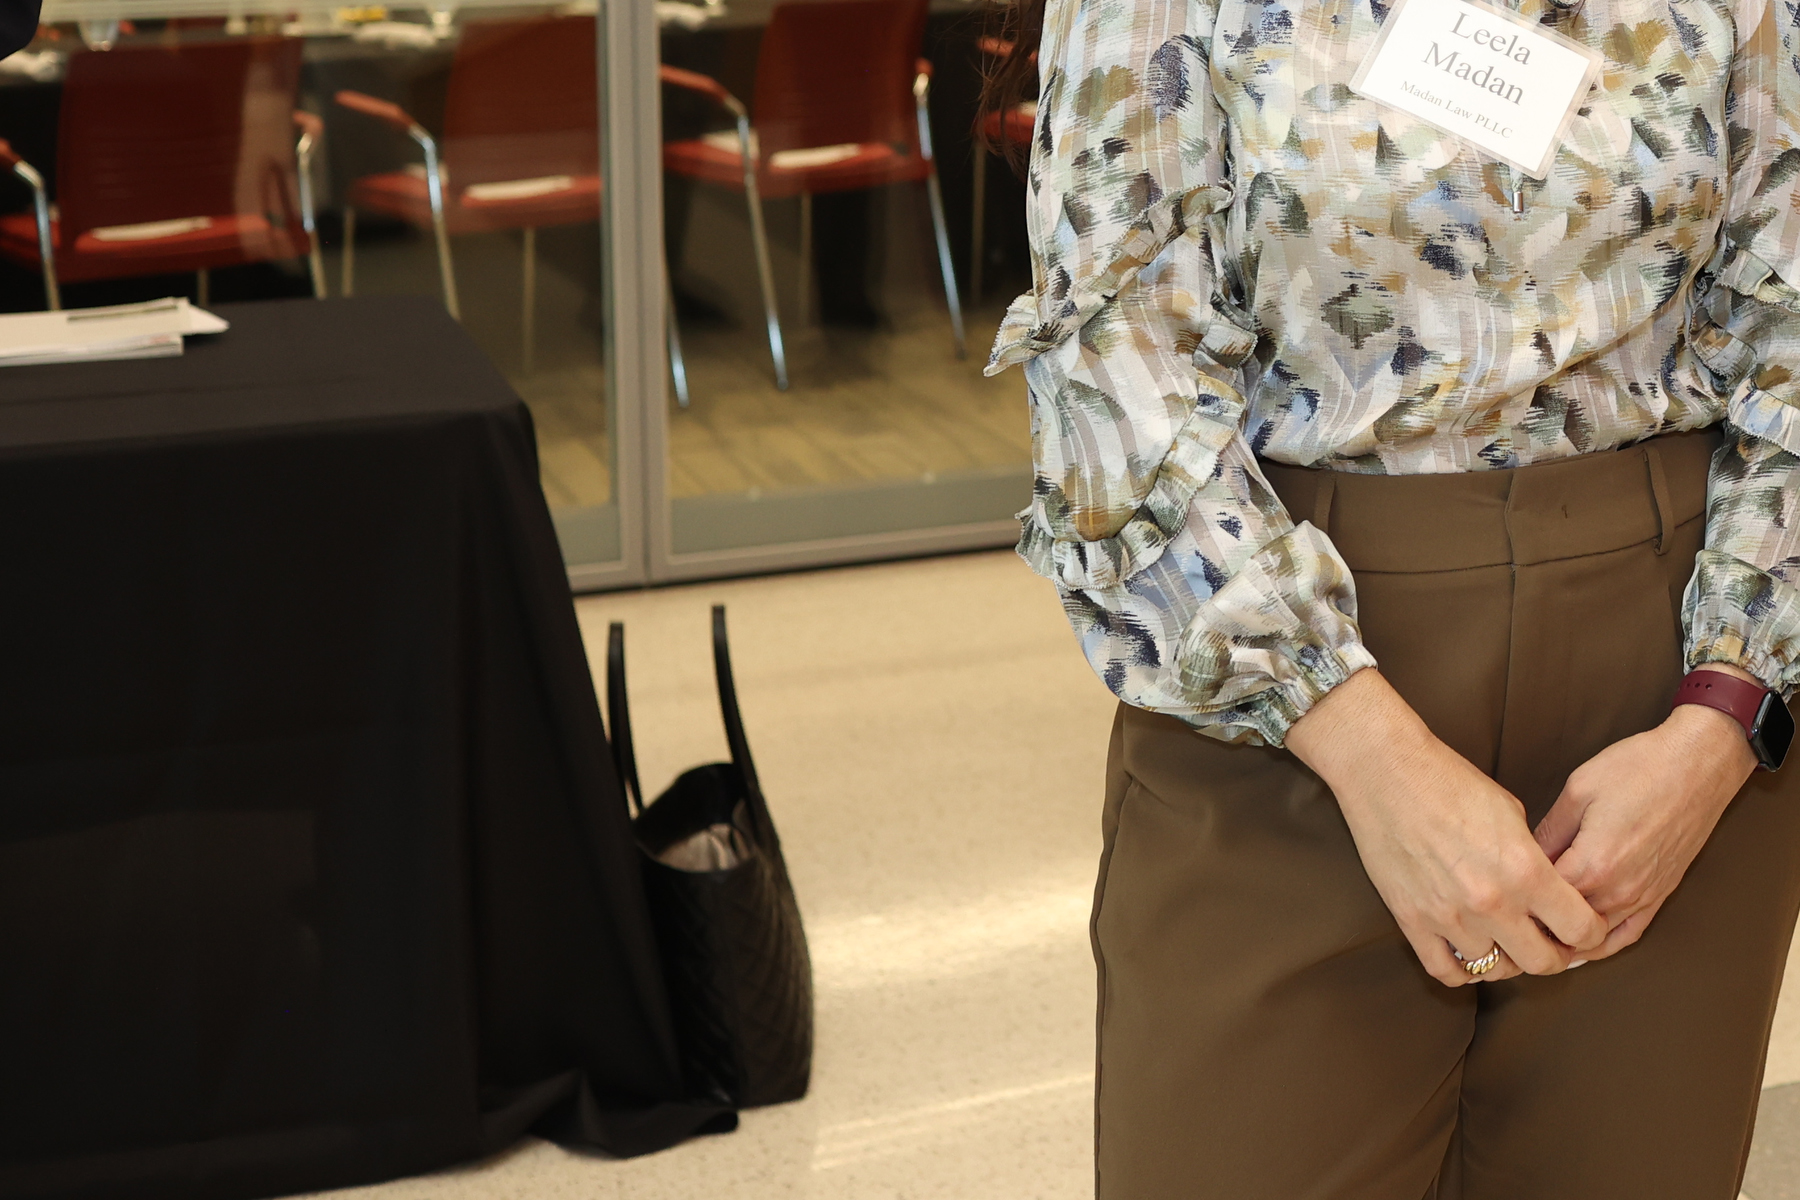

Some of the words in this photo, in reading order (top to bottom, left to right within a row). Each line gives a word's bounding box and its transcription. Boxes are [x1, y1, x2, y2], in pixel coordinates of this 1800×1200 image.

[1449, 11, 1531, 65] Leela
[1421, 41, 1524, 106] Madan
[1400, 80, 1443, 106] Madan
[1445, 100, 1473, 120] Law
[1475, 113, 1513, 139] PLLC
